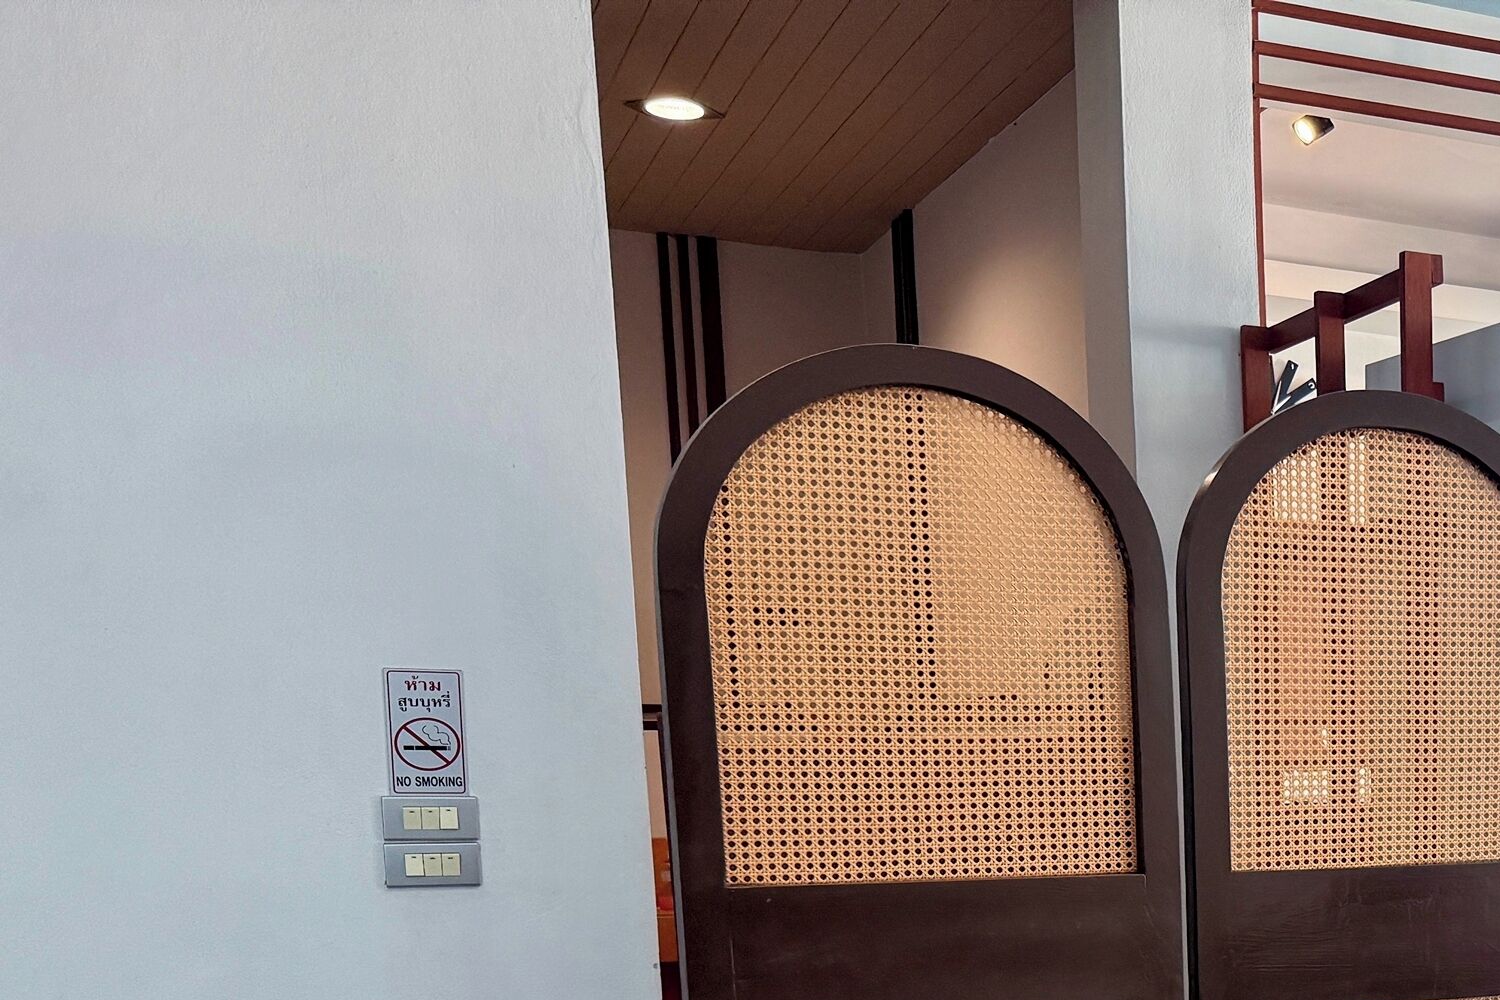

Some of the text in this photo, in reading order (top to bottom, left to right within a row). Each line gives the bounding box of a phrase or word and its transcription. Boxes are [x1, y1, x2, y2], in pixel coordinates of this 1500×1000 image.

[404, 675, 441, 692] ห้าม
[398, 691, 451, 712] สูบบุหรี่
[396, 776, 463, 787] NO SMOKING
